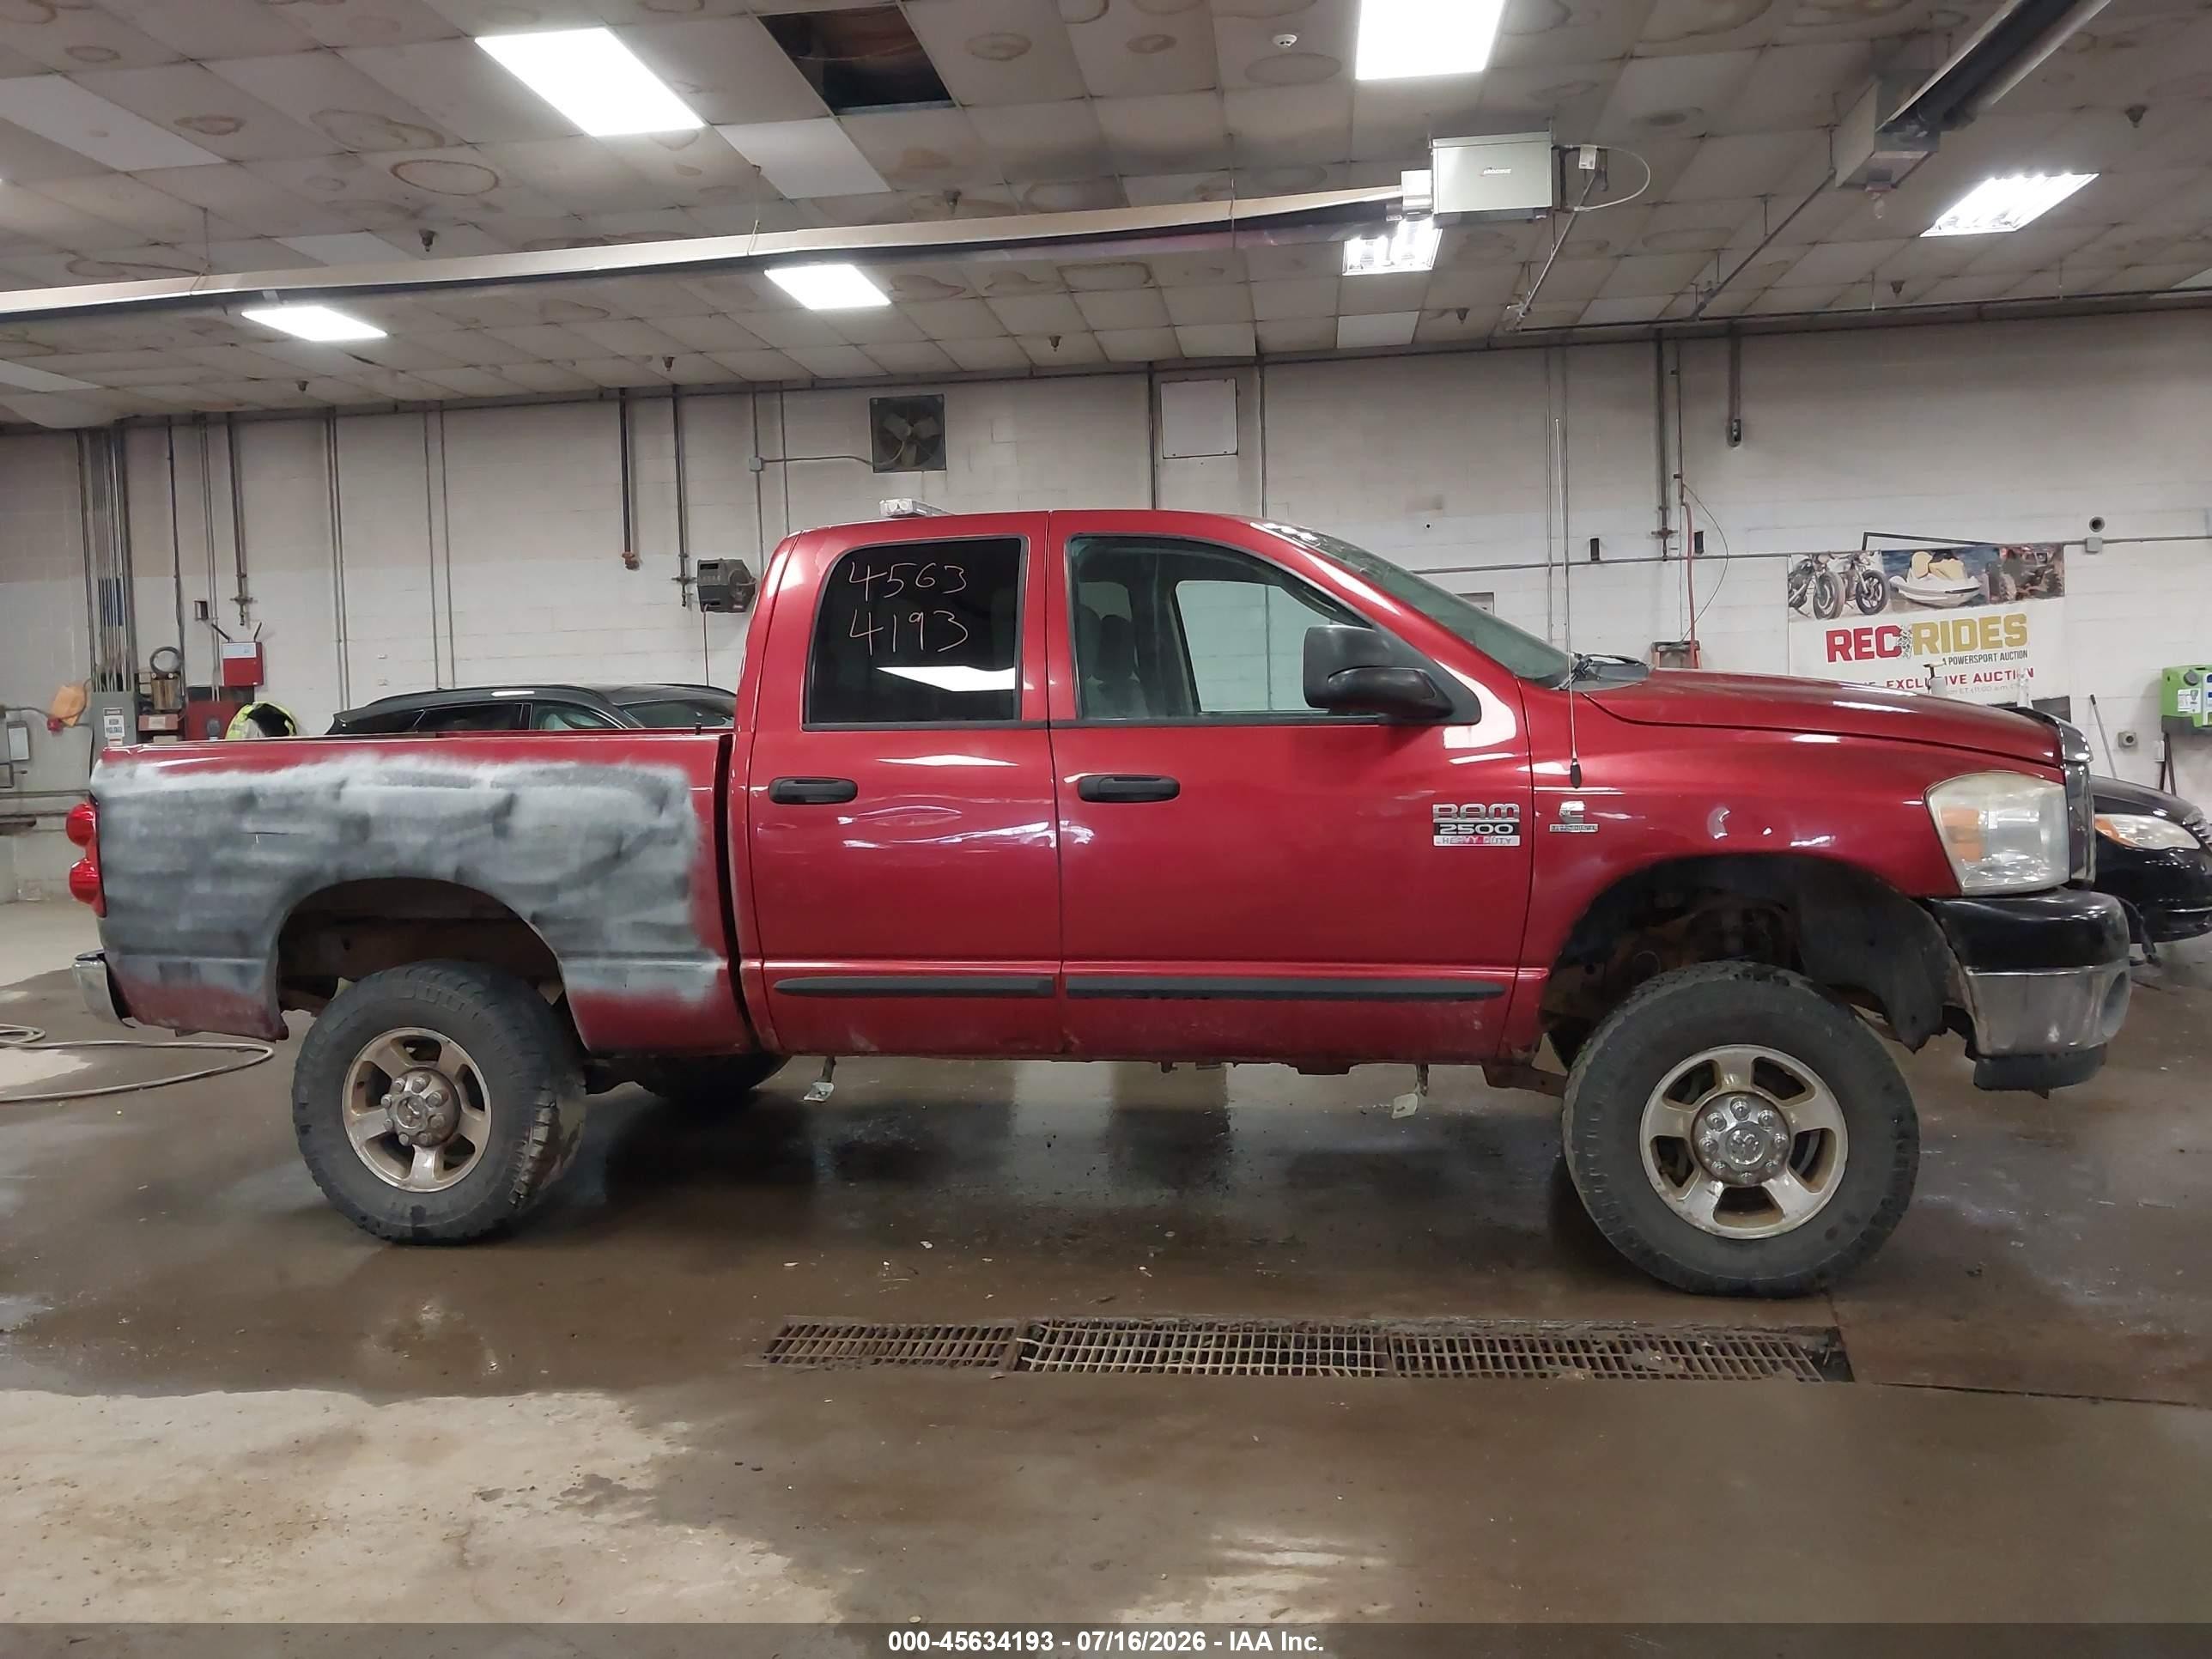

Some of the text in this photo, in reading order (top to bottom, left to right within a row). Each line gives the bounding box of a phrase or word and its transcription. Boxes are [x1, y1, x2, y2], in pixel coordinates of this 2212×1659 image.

[848, 561, 968, 602] 4563
[849, 609, 969, 656] 4193
[1826, 613, 2028, 663] REC RIDES
[1948, 653, 1998, 665] POWERSPORT
[2000, 650, 2028, 661] AUCTION
[1887, 667, 2034, 690] EXCLIVE AUCTIN
[1432, 803, 1520, 820] RAM
[1439, 823, 1514, 835] 2500
[1483, 836, 1511, 845] DUTY
